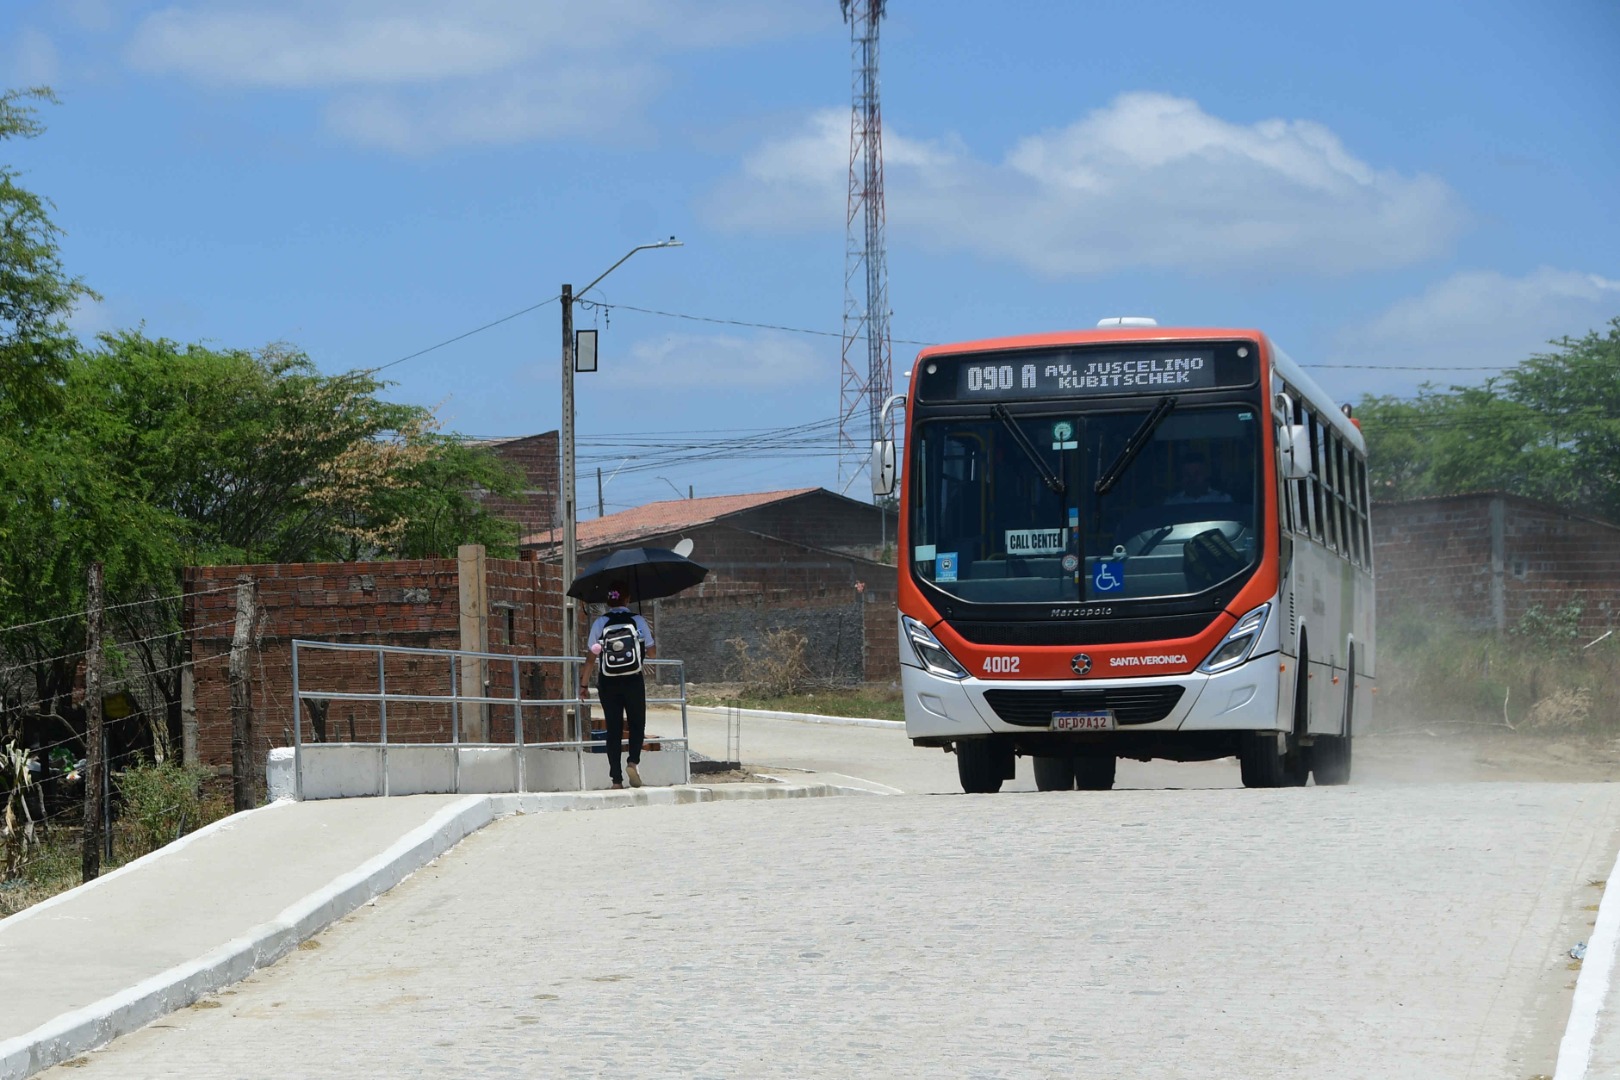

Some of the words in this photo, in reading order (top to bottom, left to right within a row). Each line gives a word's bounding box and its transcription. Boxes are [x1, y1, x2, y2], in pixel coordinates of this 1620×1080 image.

[1045, 365, 1077, 376] AV.
[1084, 358, 1203, 375] JUSCELINO
[968, 366, 1013, 390] 090
[1022, 364, 1036, 388] A
[1059, 371, 1190, 388] KUBITSCHEK
[1010, 534, 1030, 549] CALL
[1050, 607, 1112, 618] Marcopolo
[983, 656, 1020, 673] 4002
[1109, 656, 1140, 667] SANTA
[1140, 654, 1188, 666] VERONICA
[1058, 717, 1107, 729] QFD9A12
